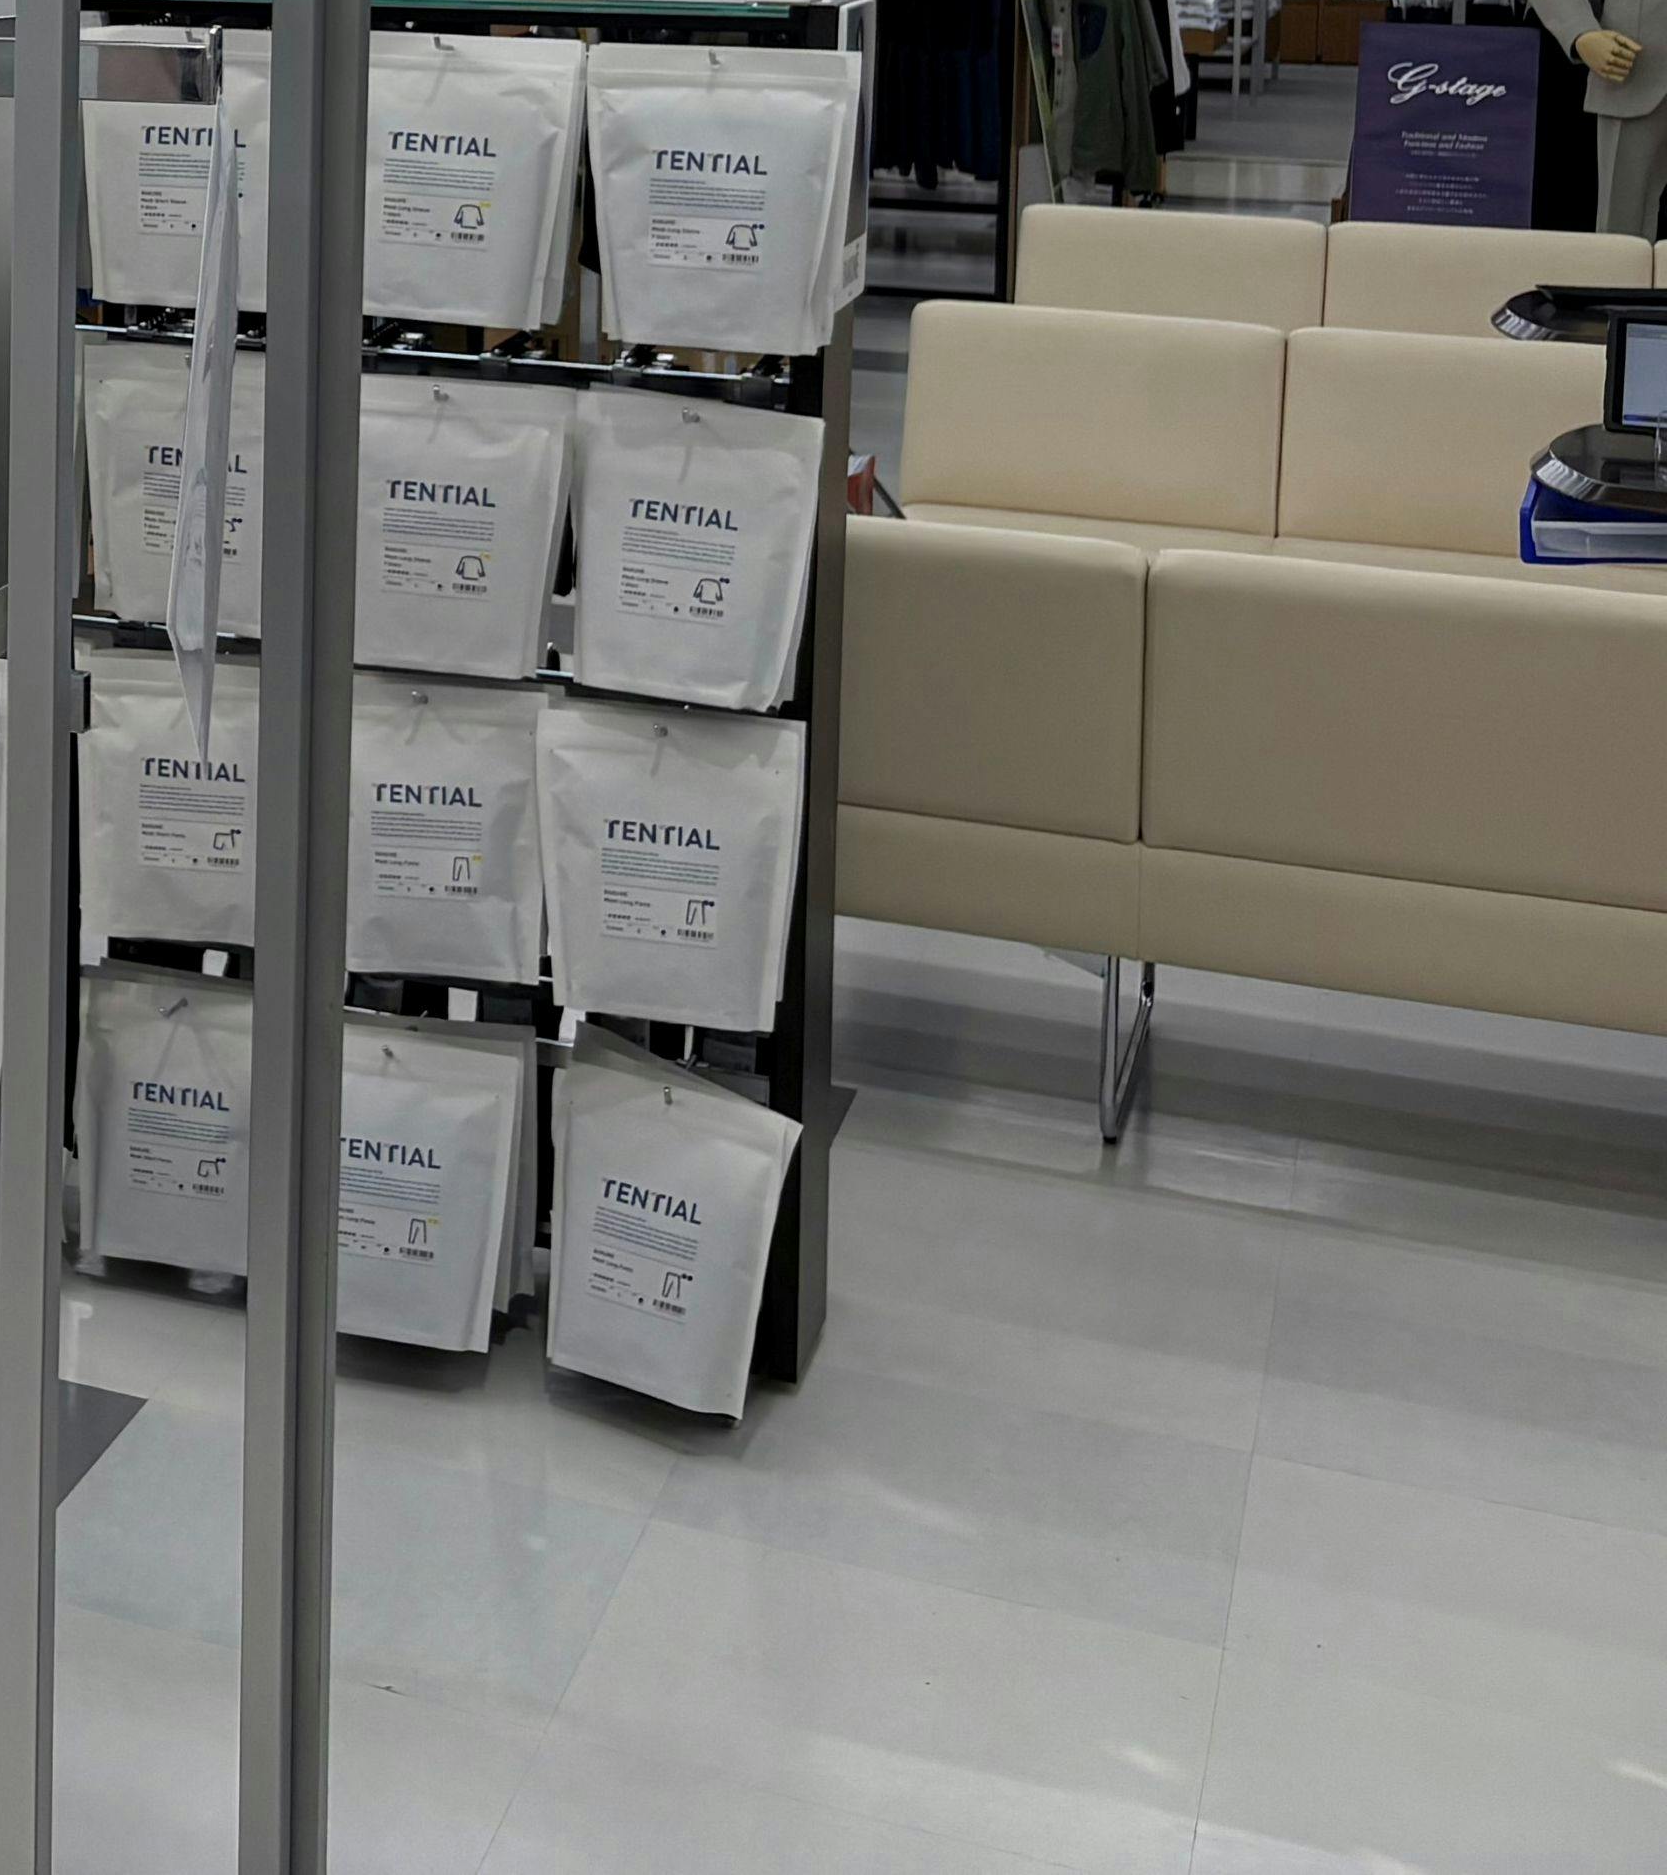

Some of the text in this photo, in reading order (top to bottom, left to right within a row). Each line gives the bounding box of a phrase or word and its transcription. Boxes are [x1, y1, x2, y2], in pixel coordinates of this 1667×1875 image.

[1387, 62, 1507, 106] G-stage
[141, 125, 246, 148] TENTIL
[389, 131, 496, 157] TENTIAL
[652, 150, 767, 175] TENTIAL
[386, 480, 496, 508] TENTIAL
[629, 499, 738, 531] TENTIAL
[372, 783, 482, 807] TENTIAL
[604, 819, 720, 850] TENTIAL
[130, 1081, 230, 1111] TENTIAL
[602, 1178, 701, 1225] TENTIAL
